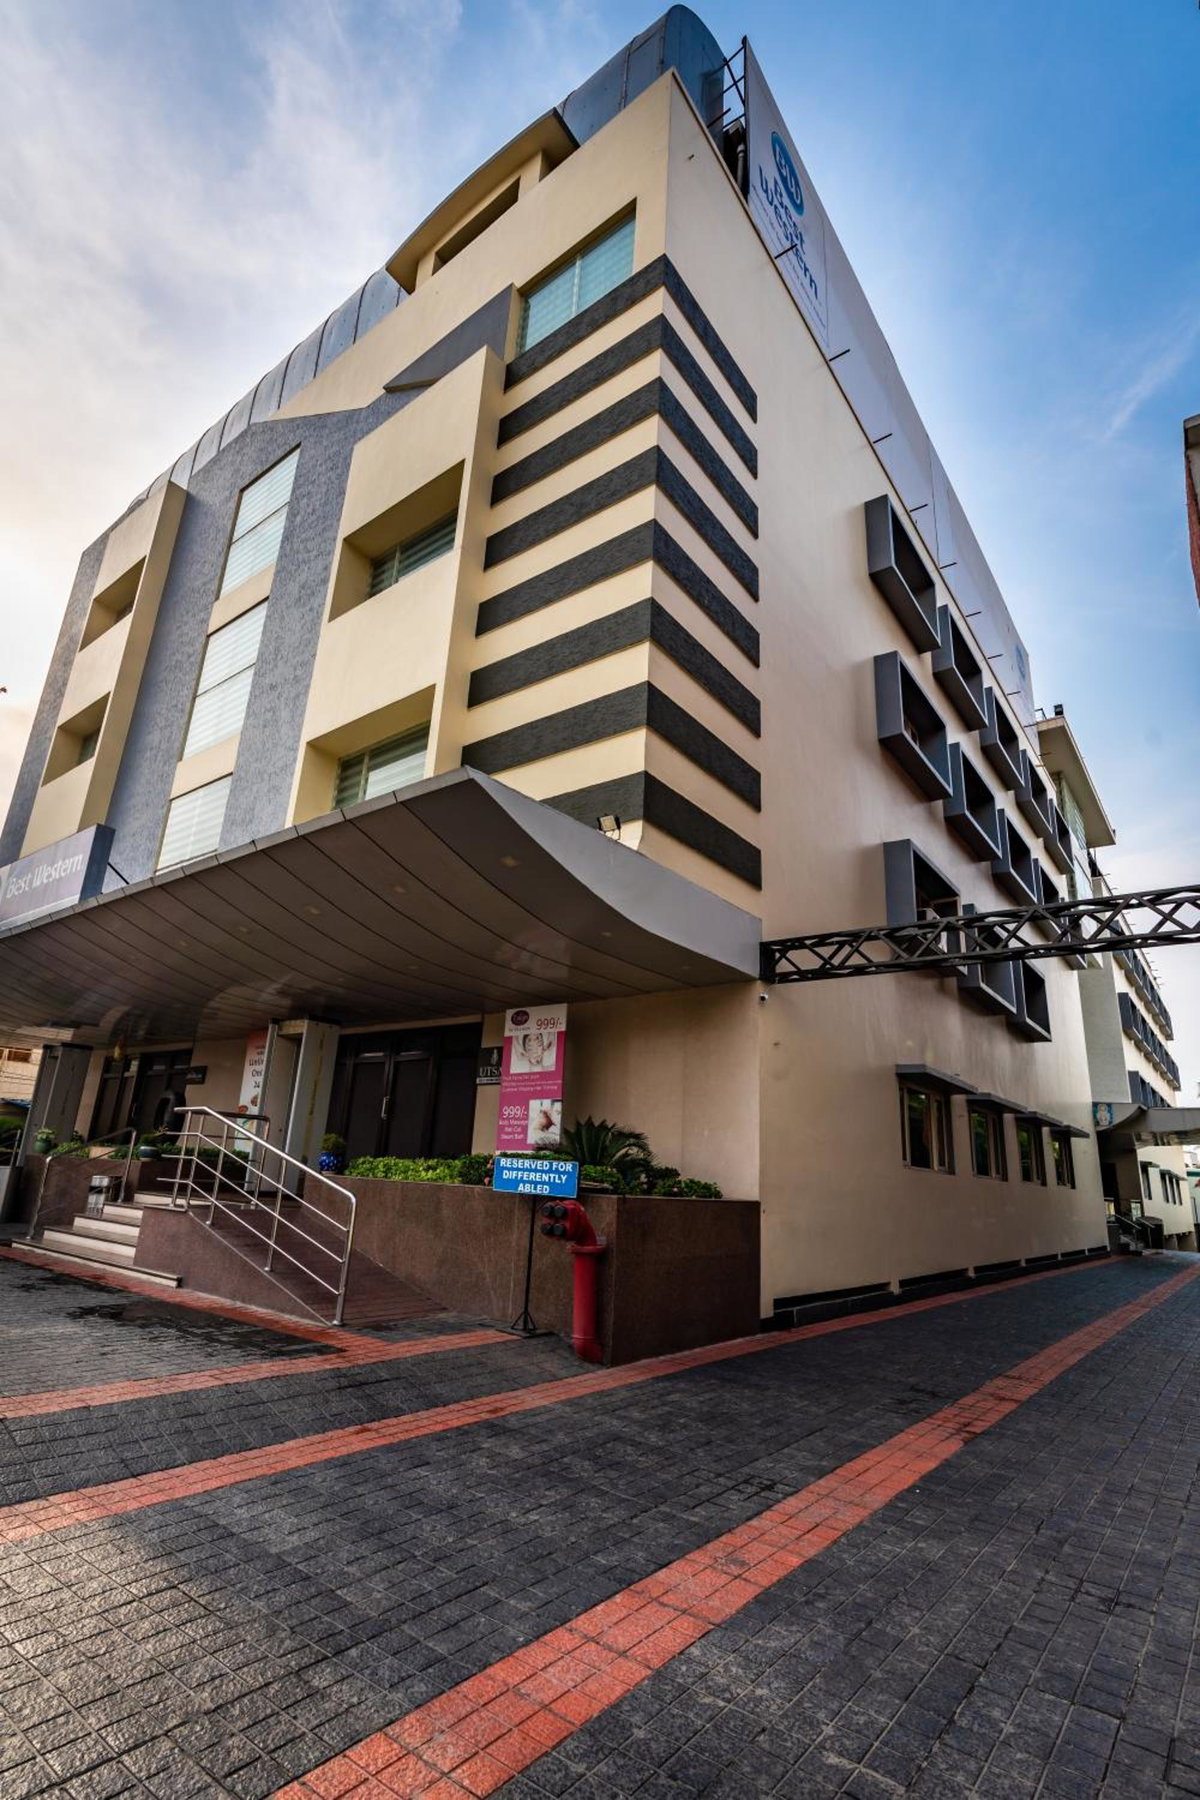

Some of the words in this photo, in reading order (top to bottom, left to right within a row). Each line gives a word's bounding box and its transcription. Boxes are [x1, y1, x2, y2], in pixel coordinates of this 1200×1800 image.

[774, 177, 806, 255] Best
[758, 163, 818, 300] Western
[6, 874, 32, 898] Best
[32, 854, 82, 888] Western
[502, 1105, 527, 1118] 999/-
[500, 1158, 549, 1170] RESERVED
[552, 1161, 573, 1172] FOR
[502, 1170, 567, 1184] DIFFERENTLY
[517, 1182, 550, 1194] ABLED
